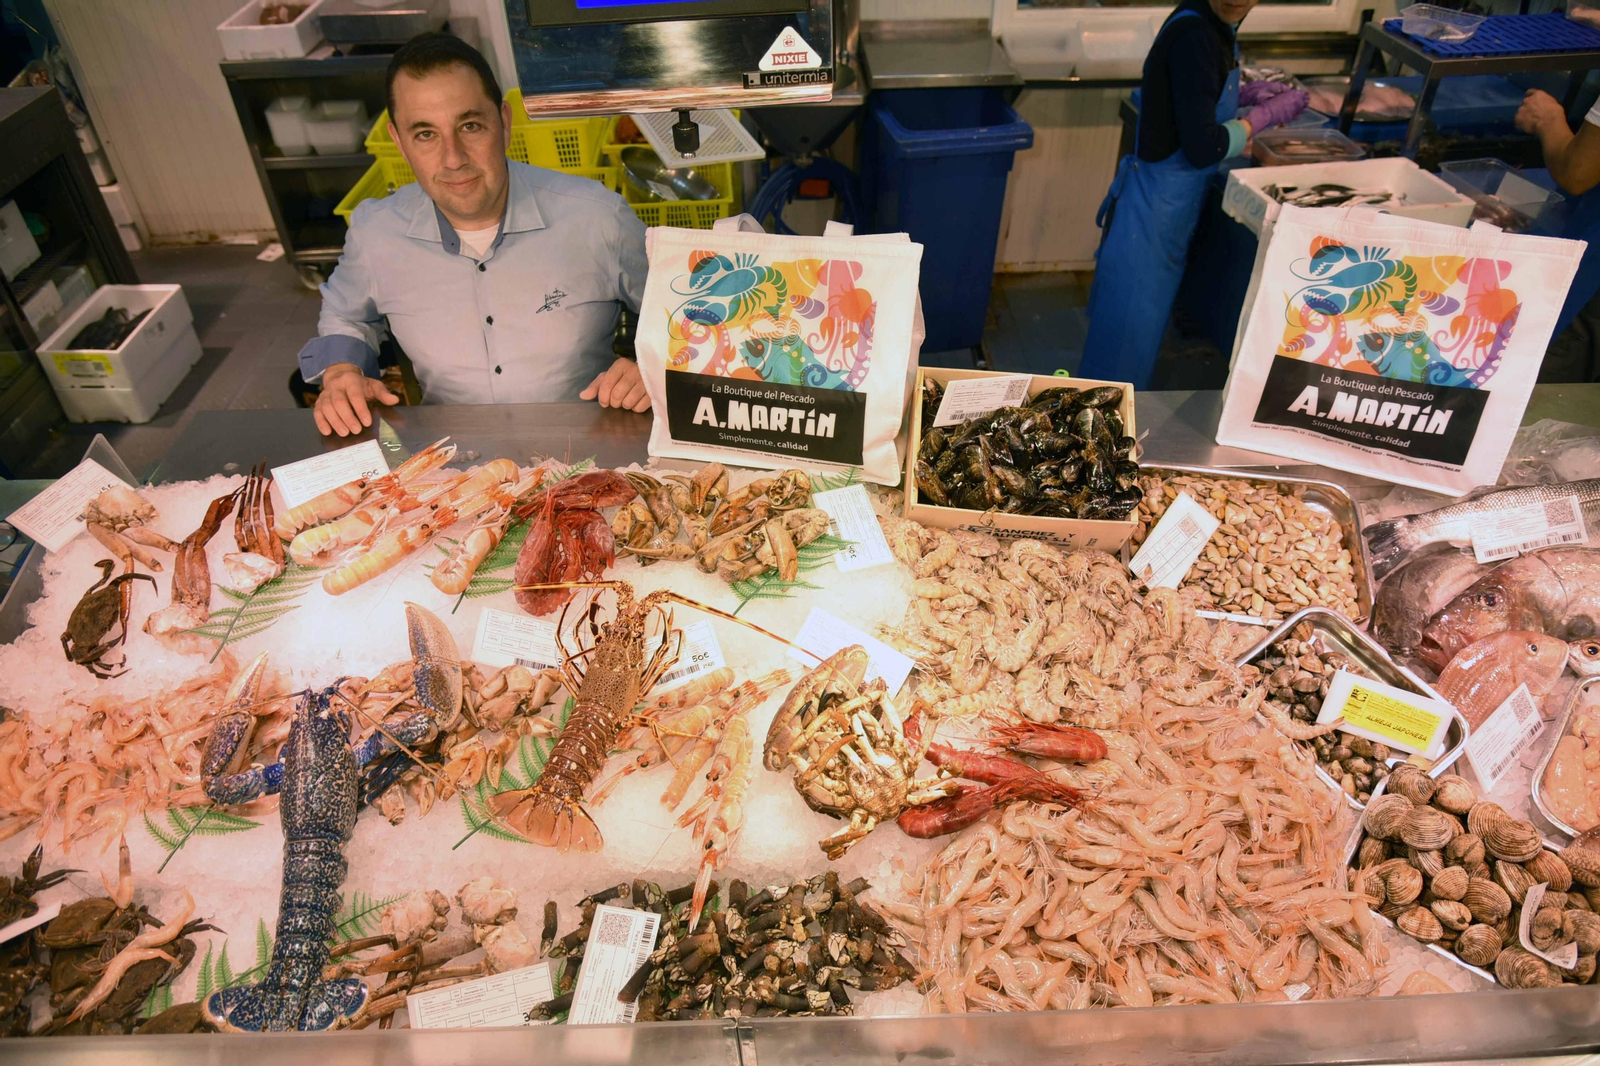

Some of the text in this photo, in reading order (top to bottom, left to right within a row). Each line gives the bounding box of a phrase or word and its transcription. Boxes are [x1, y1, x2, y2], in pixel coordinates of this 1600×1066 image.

[775, 54, 806, 64] NIXIE
[765, 70, 828, 84] unitermia
[712, 383, 815, 404] La Boutique del Pescado
[1320, 373, 1434, 402] La Boutique del Pescado
[777, 442, 809, 451] calidad
[1374, 435, 1410, 448] calidad
[992, 533, 1048, 541] ALFONSO
[993, 527, 1055, 537] SANCHEZ
[1366, 714, 1428, 742] ALMEJA JAPONESA
